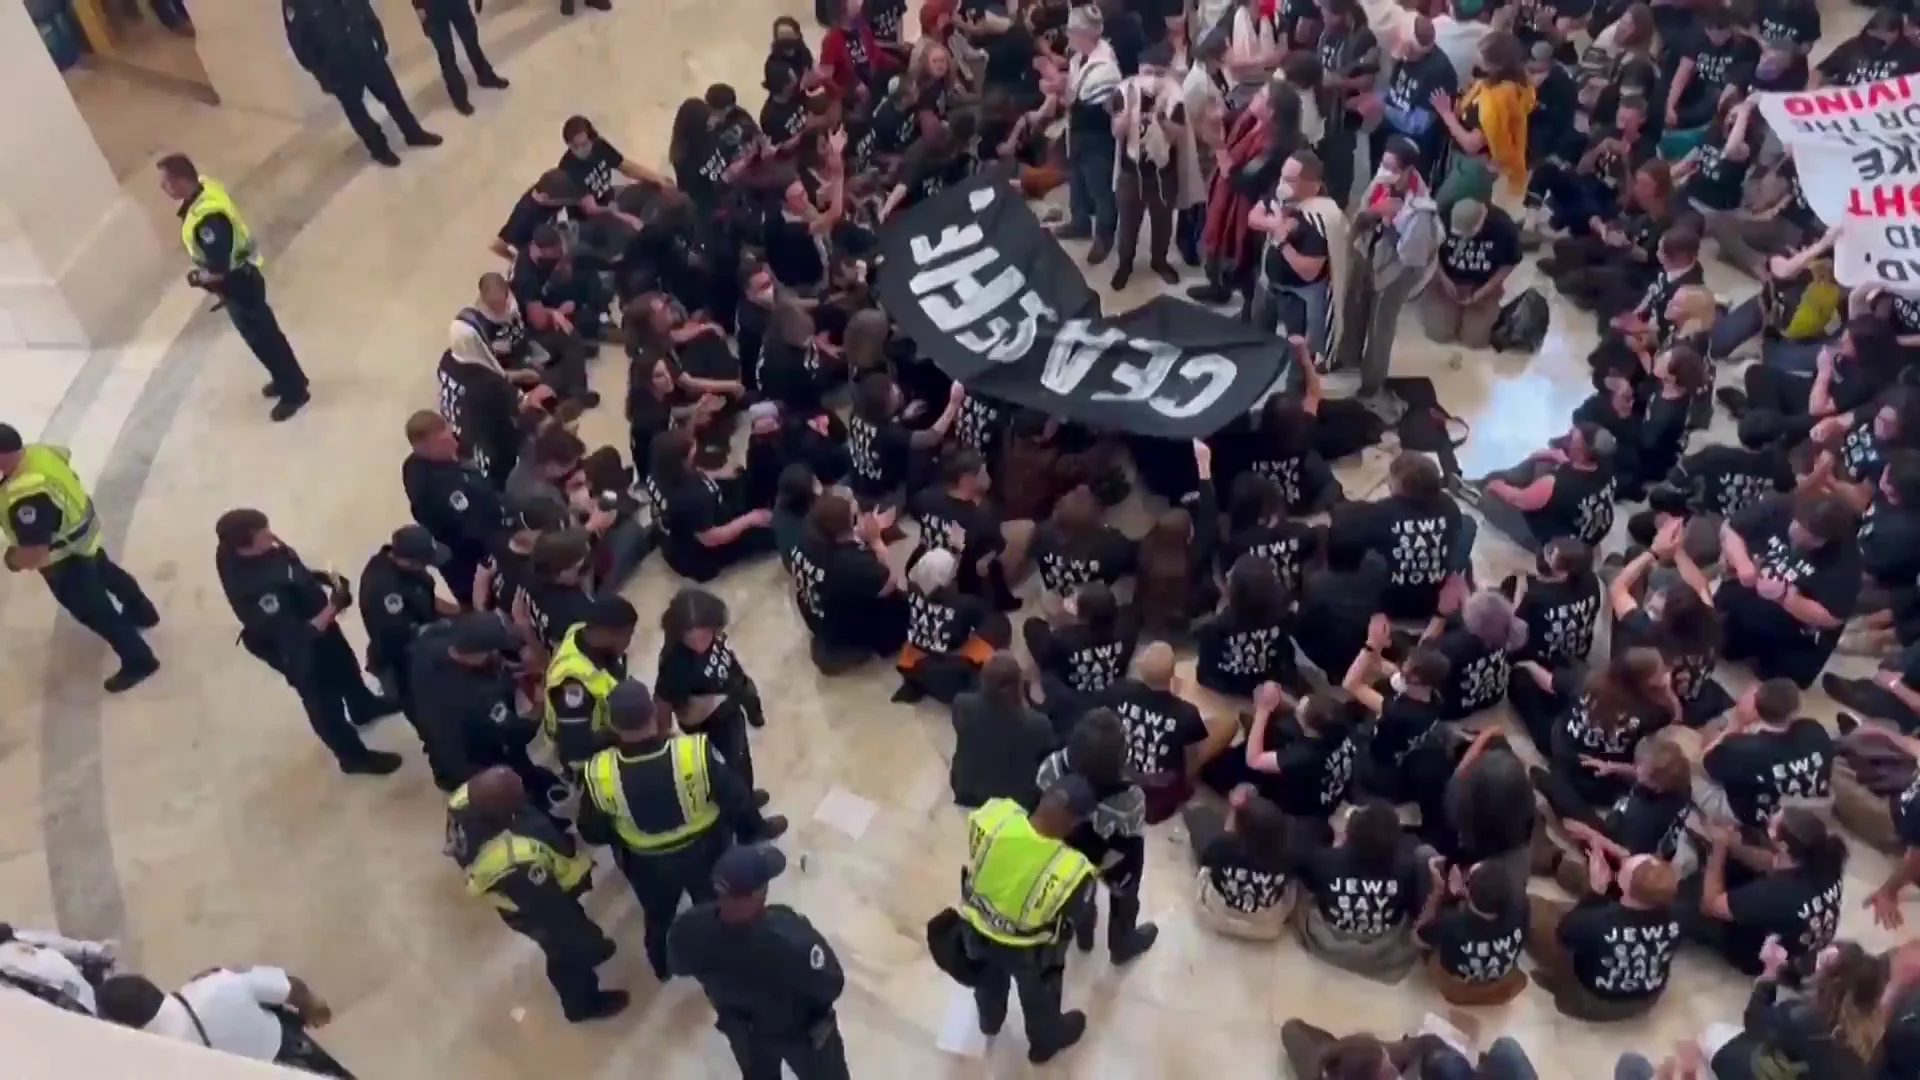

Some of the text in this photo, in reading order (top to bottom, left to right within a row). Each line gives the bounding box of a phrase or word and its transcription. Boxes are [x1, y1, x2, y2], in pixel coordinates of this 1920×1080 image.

[1391, 516, 1446, 534] JEWS
[1400, 533, 1443, 549] SAY
[1391, 568, 1447, 586] NOW
[1117, 701, 1177, 733] JEWS
[1329, 876, 1398, 896] JEWS
[1338, 895, 1389, 911] SAY
[1460, 927, 1522, 957] JEWS
[1604, 921, 1680, 944] JEWS
[1614, 940, 1669, 959] SAY
